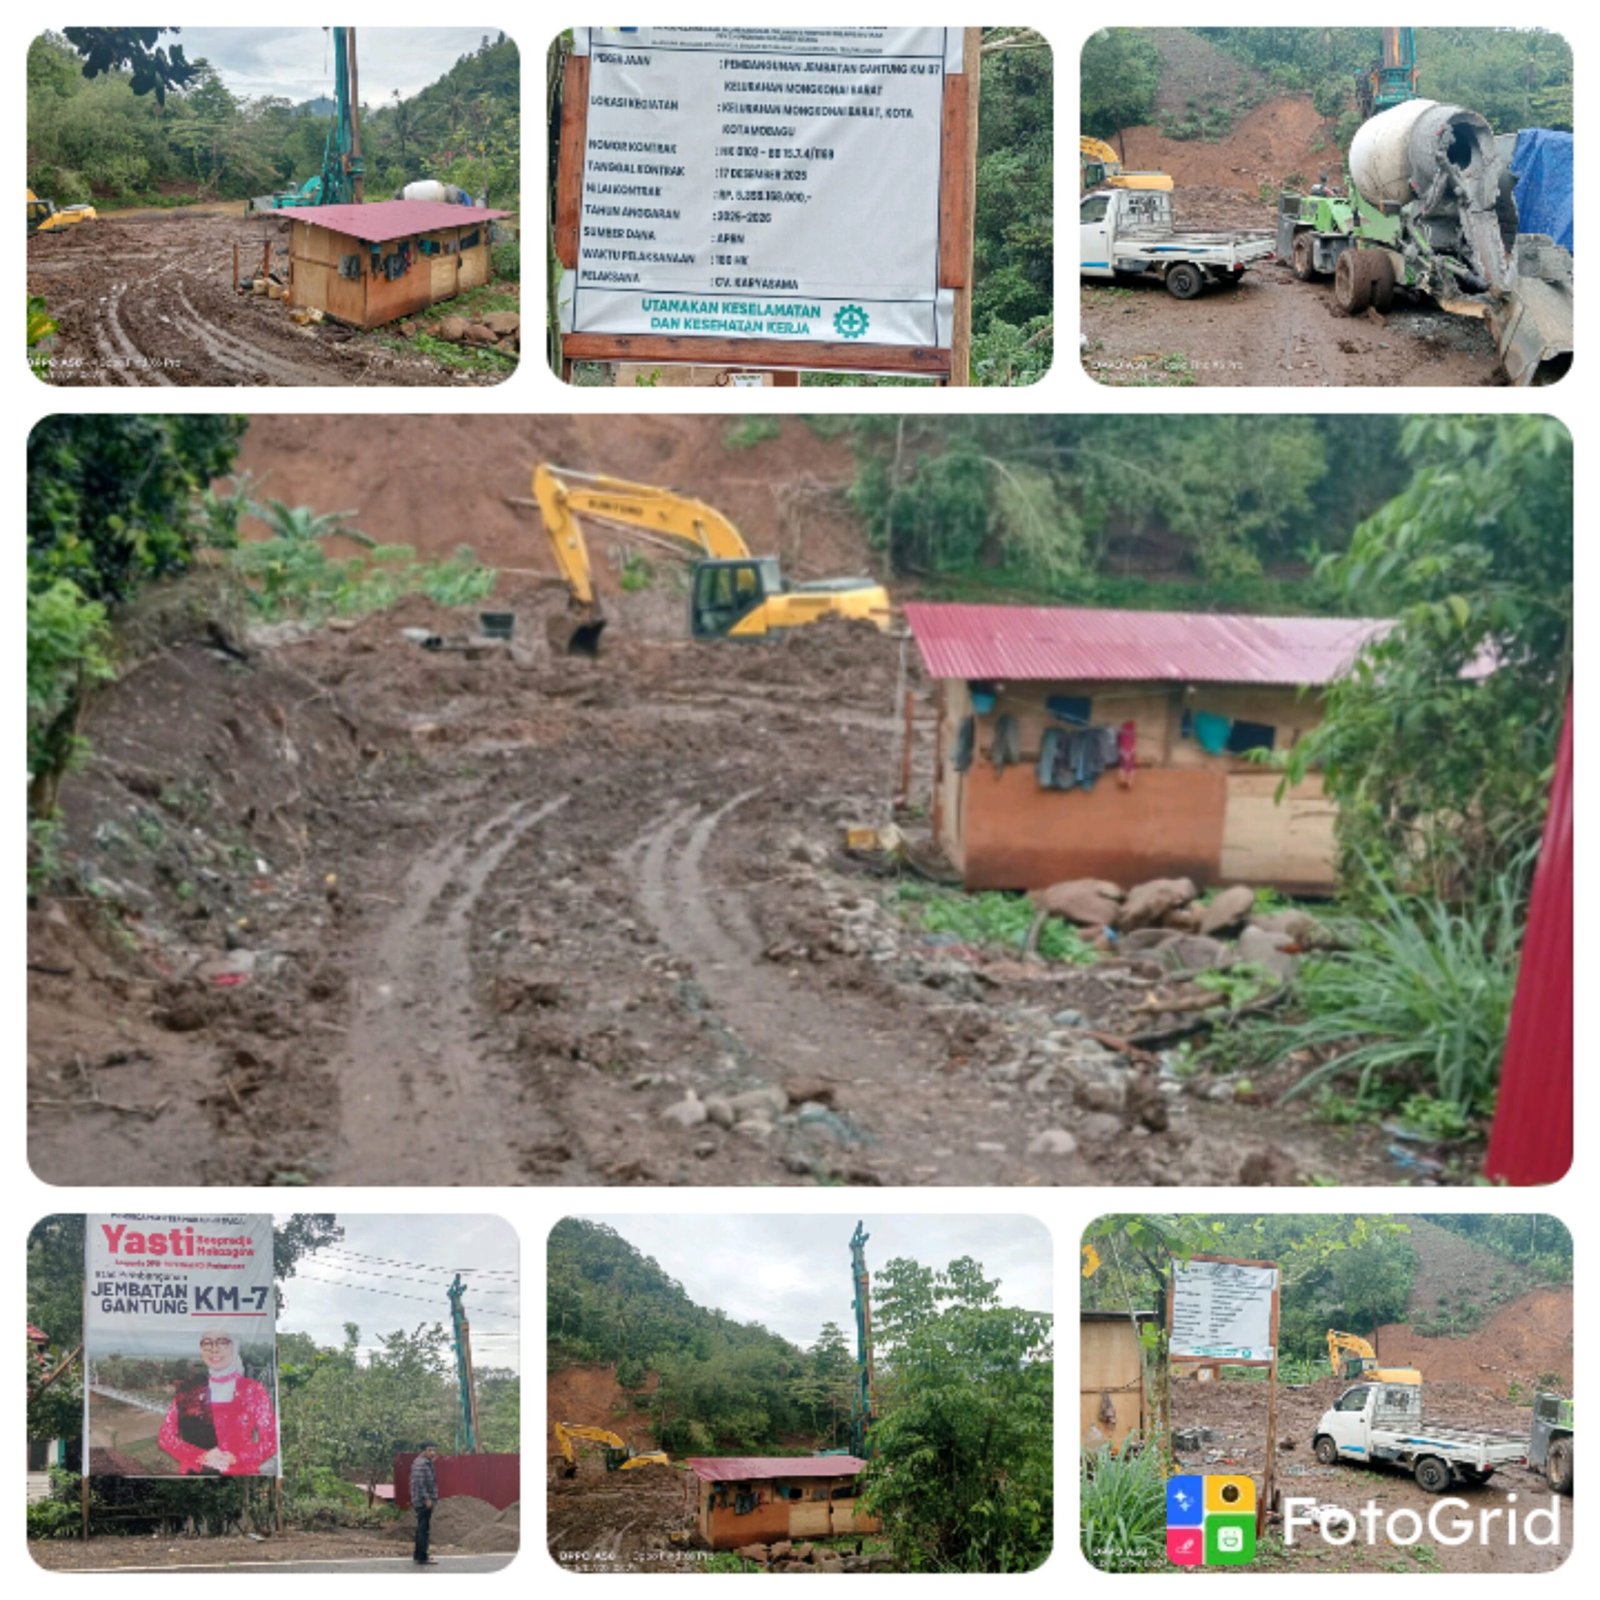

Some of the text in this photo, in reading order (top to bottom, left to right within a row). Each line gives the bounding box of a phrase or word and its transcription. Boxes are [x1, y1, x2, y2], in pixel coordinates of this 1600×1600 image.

[724, 58, 801, 72] PEMBANGUNAN
[803, 61, 857, 74] JEMBATAN
[859, 63, 908, 75] GANTUNG
[724, 81, 783, 93] KELURAHAN
[851, 85, 883, 96] BARAT
[591, 95, 627, 107] LOKASI
[629, 97, 679, 110] KEGIATAN
[722, 102, 781, 115] KELURAHAN
[885, 107, 913, 118] KOTA
[722, 124, 796, 137] KOTAMOBAGU
[588, 139, 627, 152] NOMOR
[629, 142, 677, 154] KONTRAK
[588, 160, 635, 173] TANGGAL
[637, 164, 685, 176] KONTRAK
[730, 168, 781, 180] DESEMBER
[586, 182, 612, 194] NILAI
[613, 184, 662, 197] KONTRAK
[585, 204, 620, 217] TAHUN
[622, 206, 680, 219] ANGGARAN
[583, 226, 625, 239] SUMBER
[626, 229, 656, 241] DANA
[717, 232, 745, 243] APBN
[582, 248, 620, 261] WAKTU
[622, 250, 696, 263] PELAKSANAAN
[582, 270, 641, 283] PELAKSANA
[642, 298, 822, 318] UTAMAKAN KESELAMATAN
[651, 317, 810, 334] DAN KESEHATAN KERJA
[101, 1224, 194, 1257] Yasti
[91, 1282, 188, 1299] JEMBATAN
[194, 1286, 269, 1311] KM-7
[101, 1299, 188, 1315] GANTUNG
